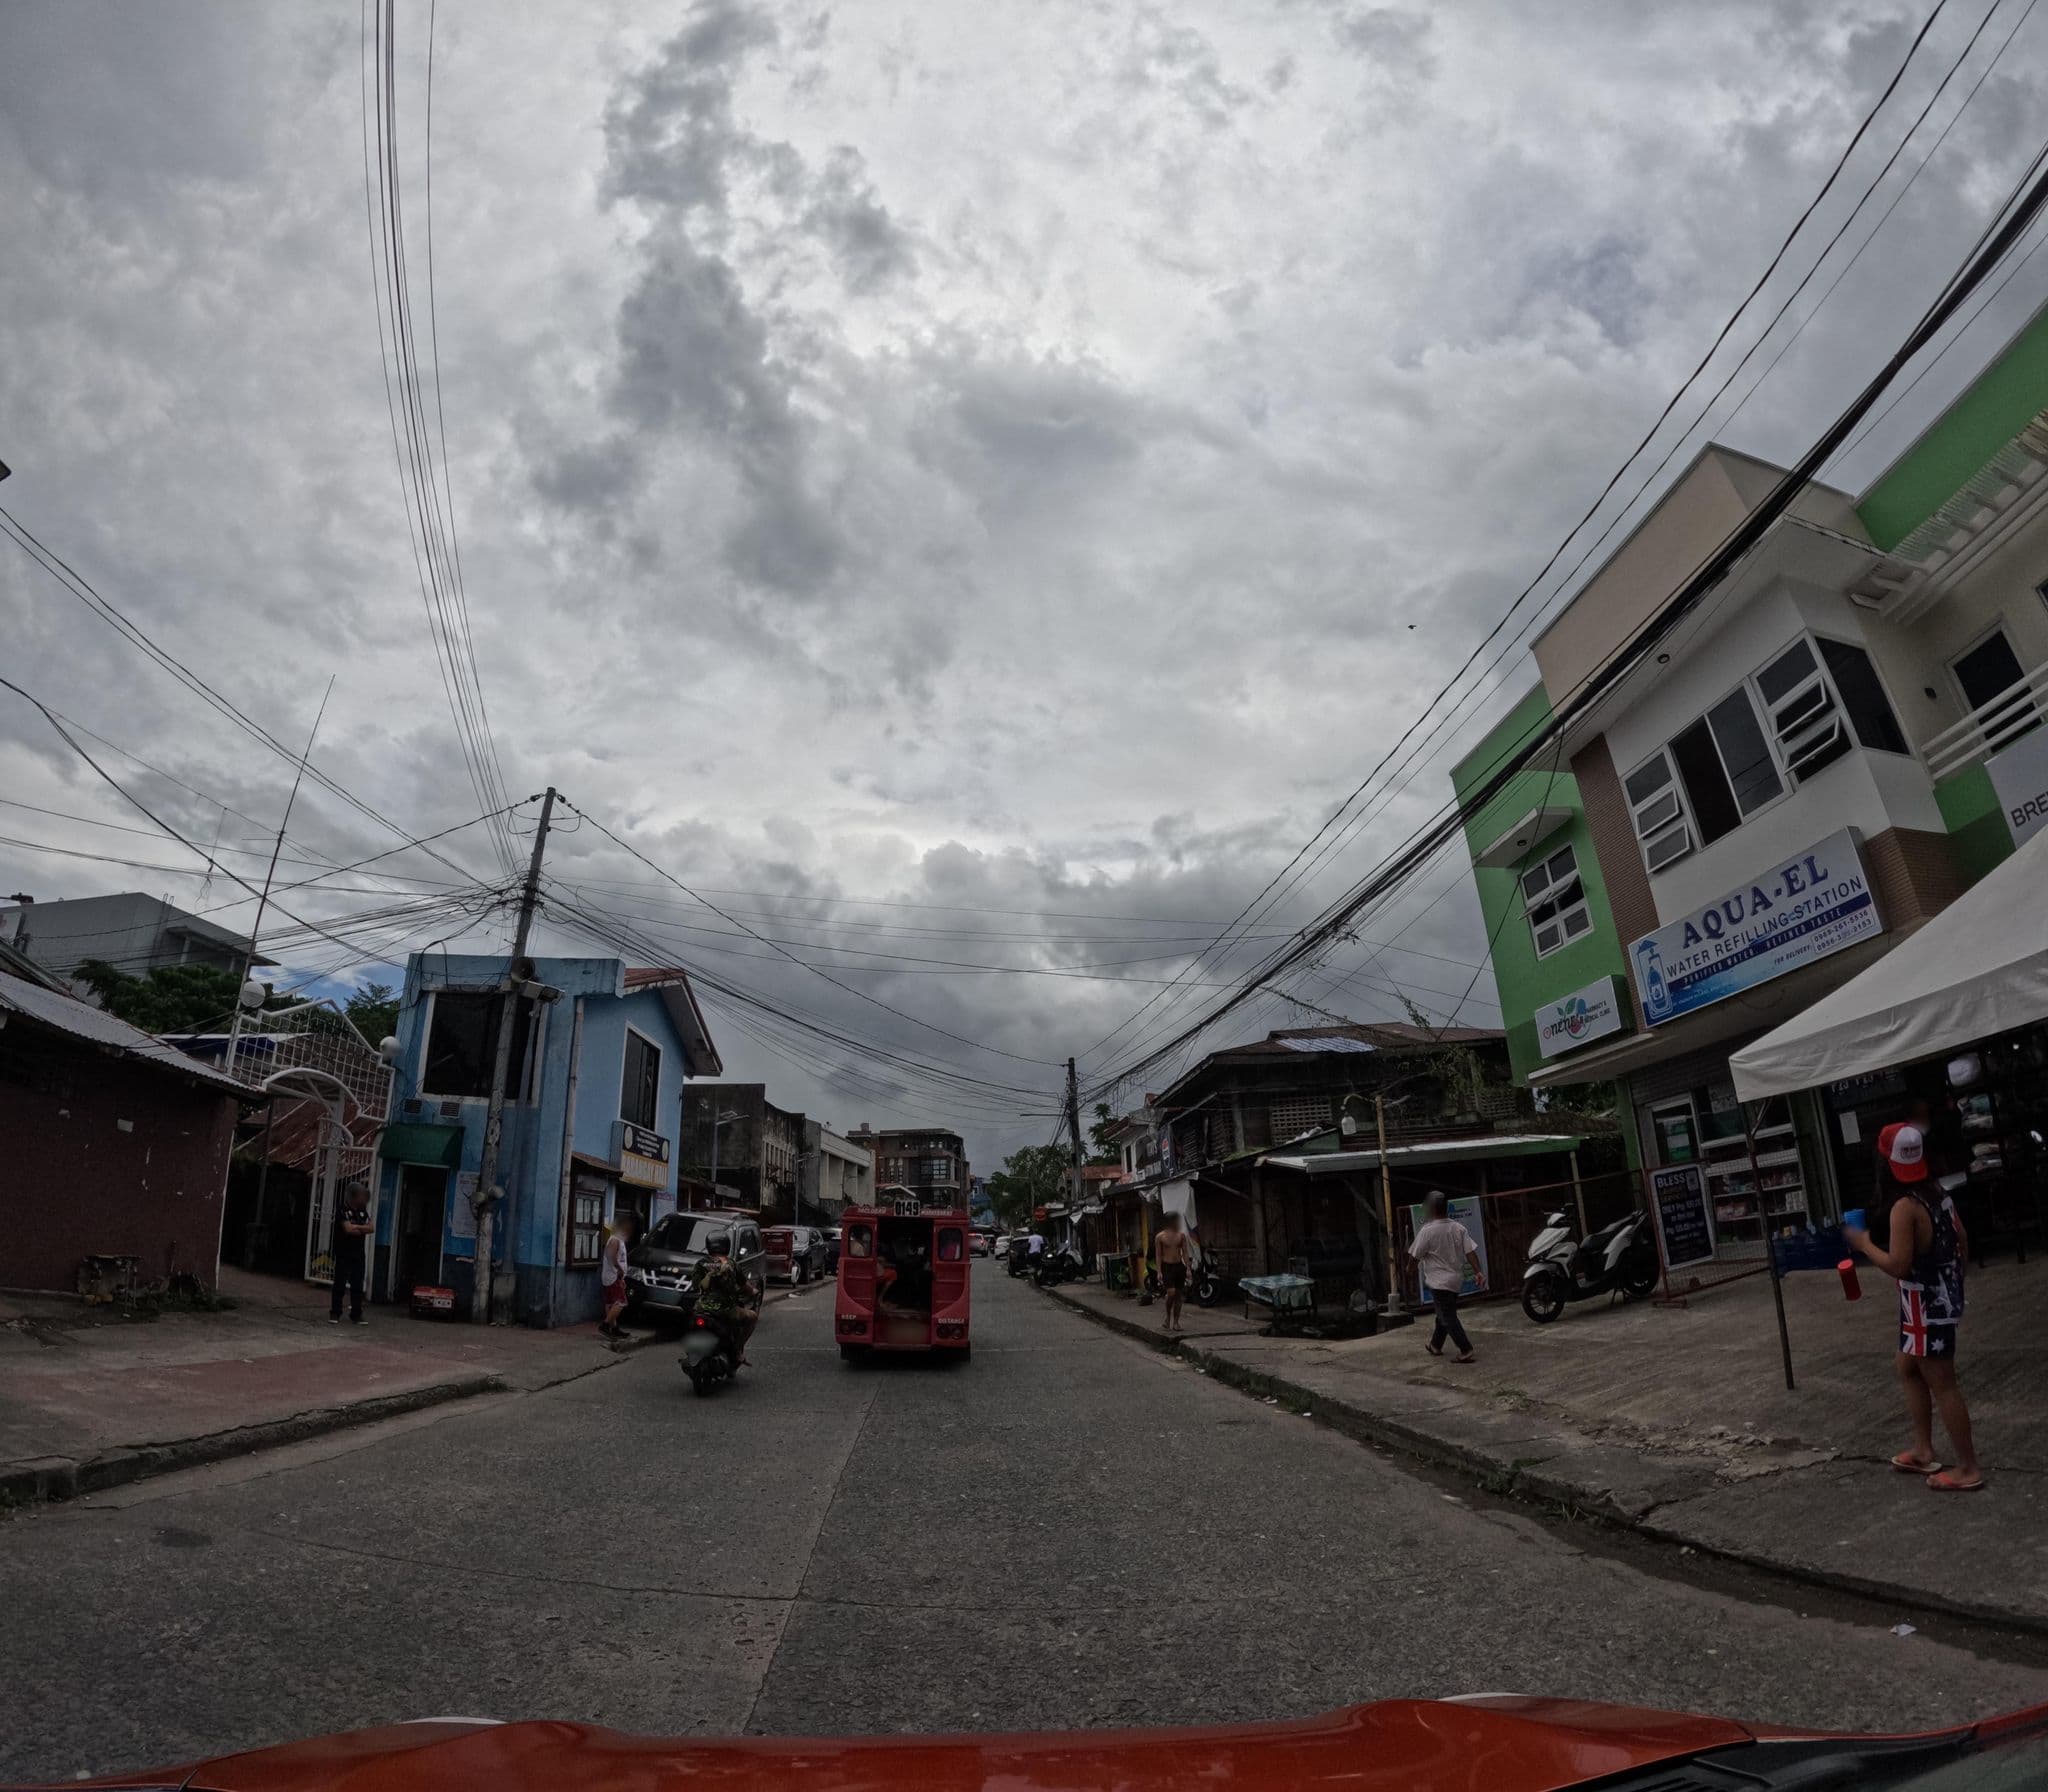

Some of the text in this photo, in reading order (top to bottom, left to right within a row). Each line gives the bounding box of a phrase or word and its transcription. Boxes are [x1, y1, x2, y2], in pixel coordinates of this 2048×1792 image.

[2010, 790, 2048, 828] BRE
[1667, 875, 1863, 978] WATER REFILLING STATION
[1682, 855, 1829, 950] AQUA-EL
[895, 1201, 919, 1215] 0149
